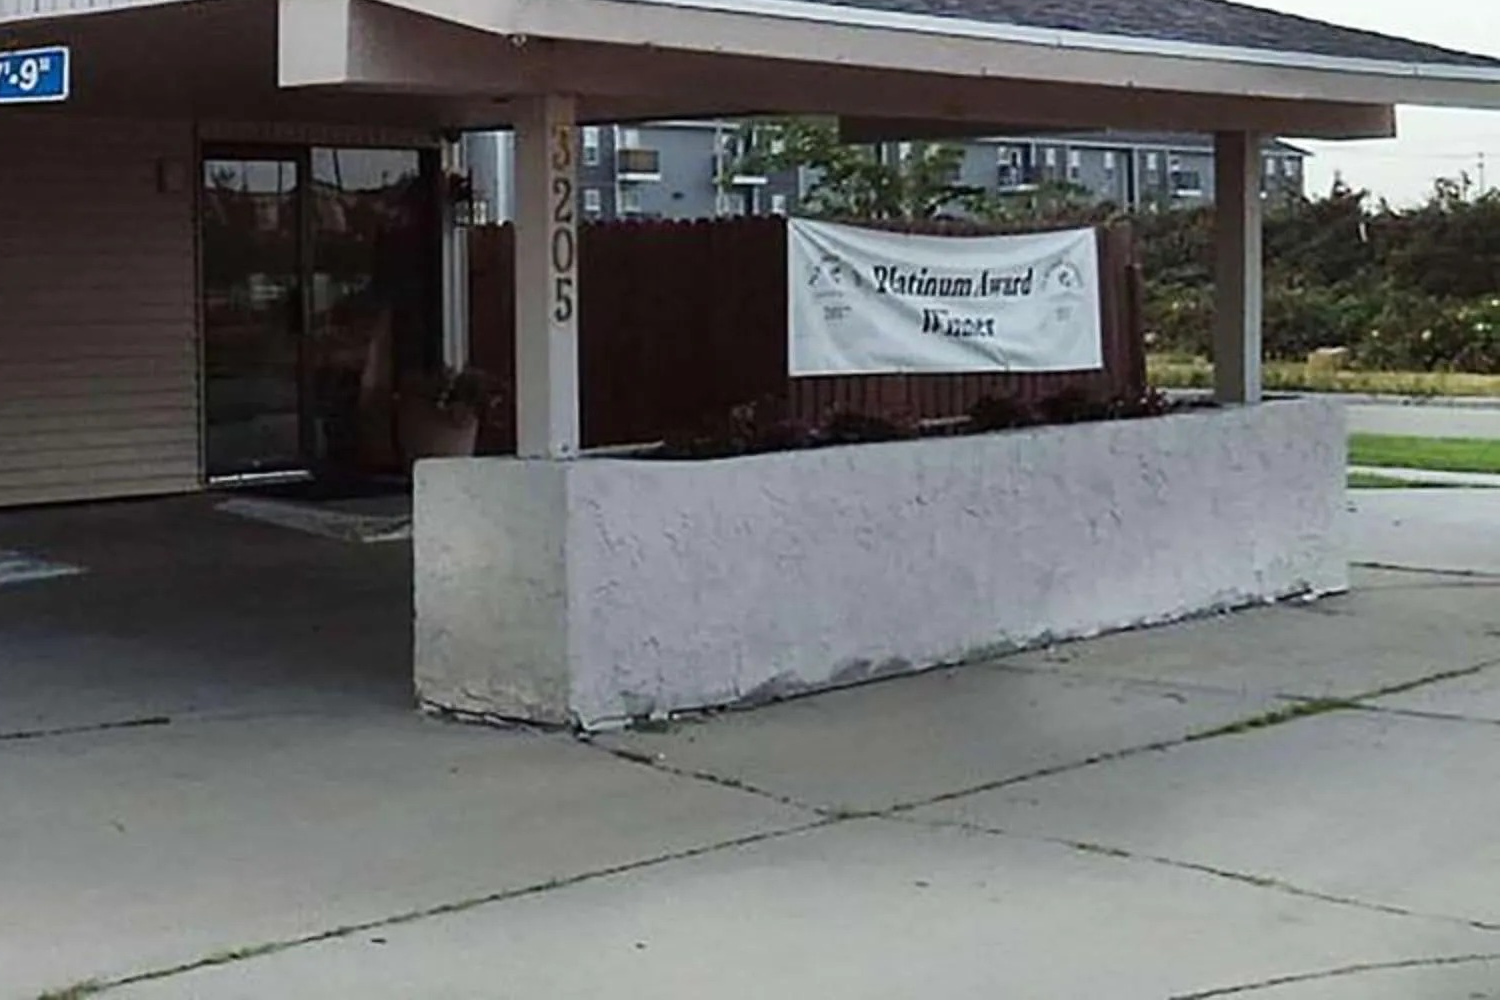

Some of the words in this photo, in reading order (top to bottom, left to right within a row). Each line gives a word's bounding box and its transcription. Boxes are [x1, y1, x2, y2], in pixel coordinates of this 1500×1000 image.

[552, 124, 574, 322] 3205
[874, 265, 973, 297] Platinum
[974, 267, 1033, 297] Award
